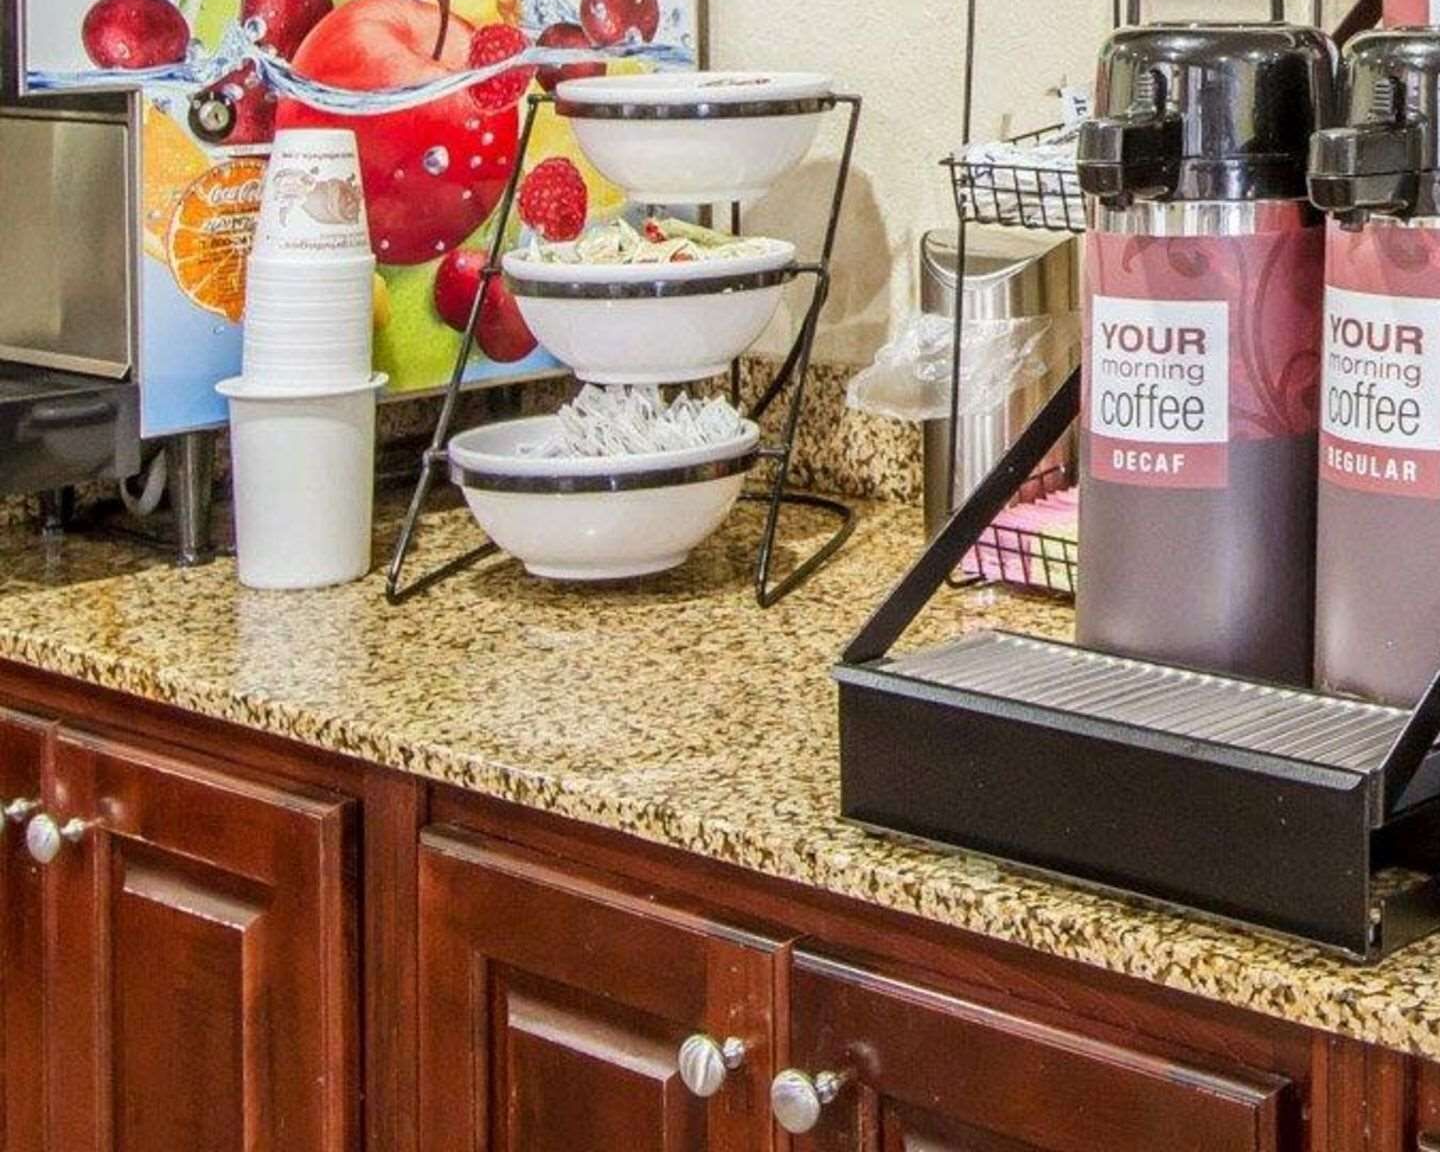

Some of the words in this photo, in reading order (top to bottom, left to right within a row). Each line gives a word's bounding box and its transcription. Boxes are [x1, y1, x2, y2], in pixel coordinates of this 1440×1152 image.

[1101, 322, 1207, 355] YOUR
[1330, 313, 1424, 355] YOUR
[1102, 358, 1205, 387] morning
[1329, 352, 1422, 388] morning
[1101, 383, 1206, 431] coffee
[1328, 381, 1420, 436] coffee
[1113, 449, 1185, 473] DECAF
[1327, 446, 1417, 481] REGULAR
